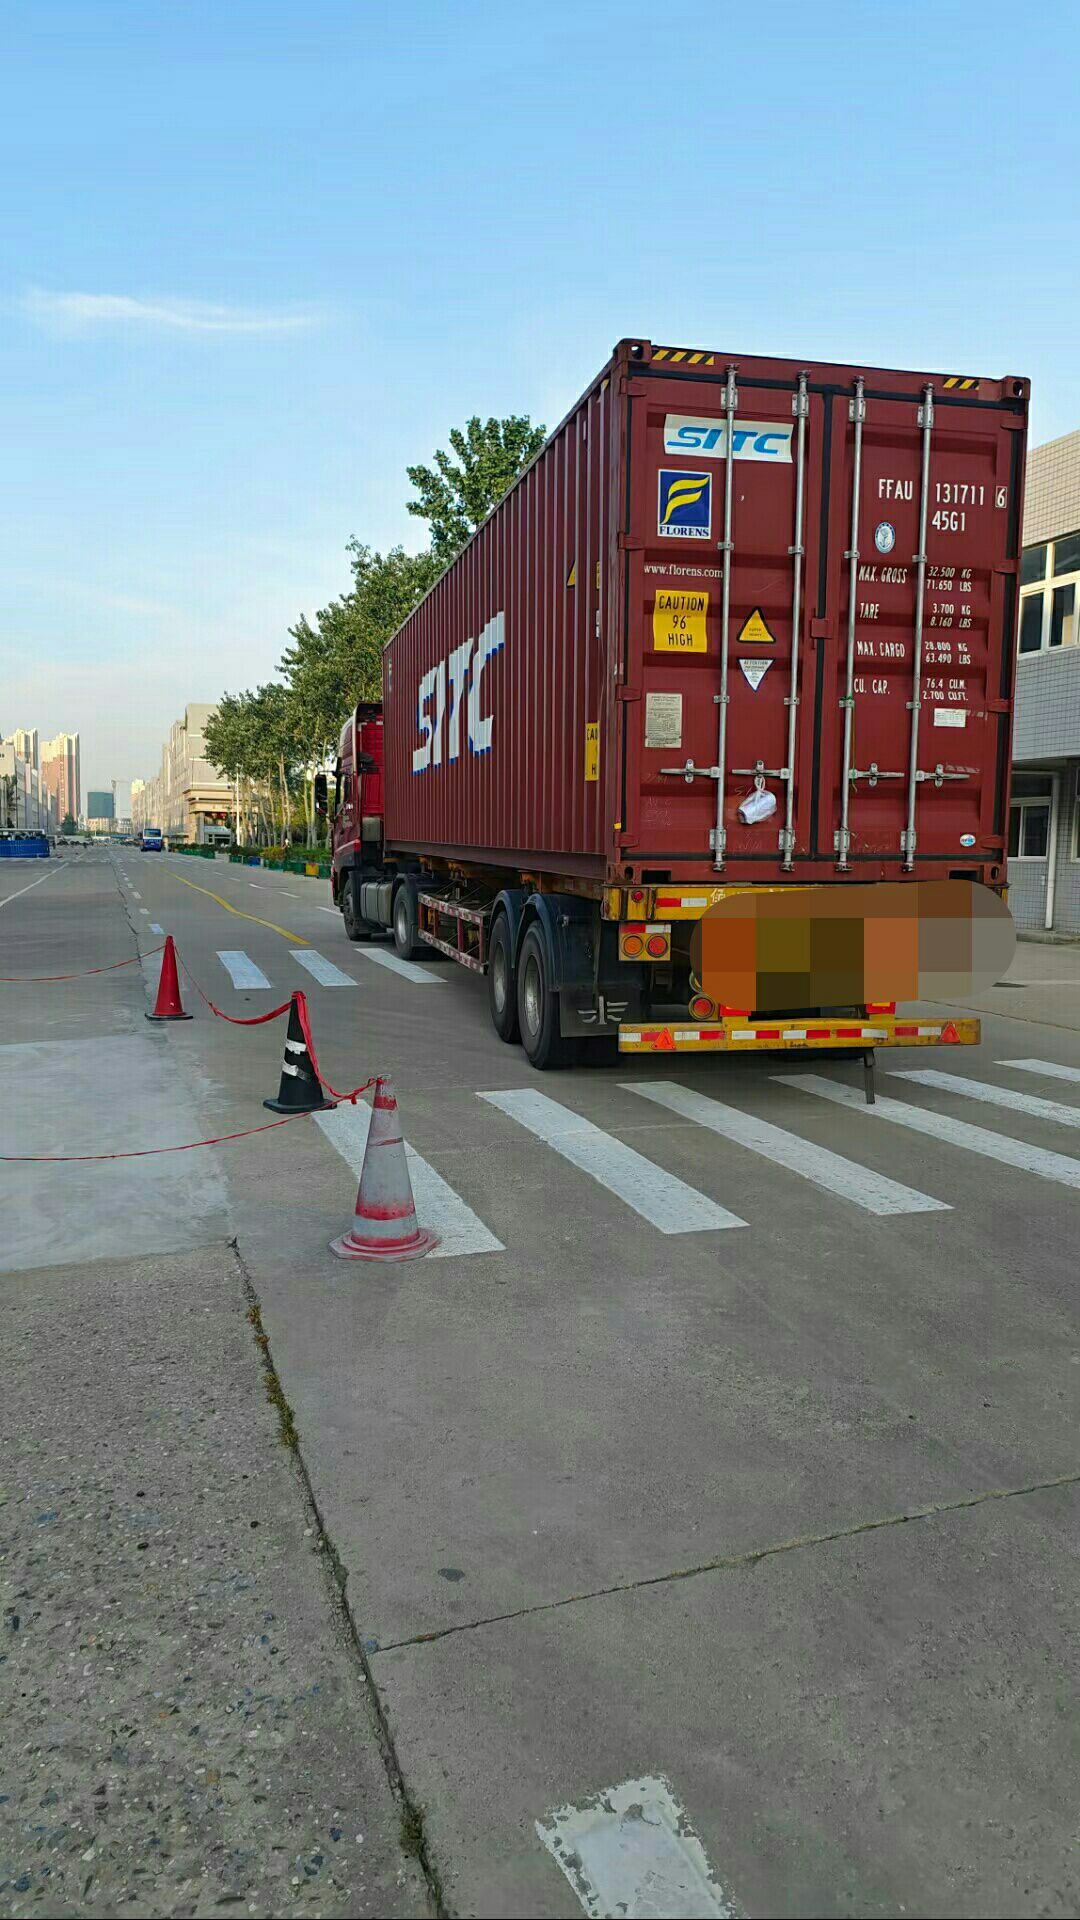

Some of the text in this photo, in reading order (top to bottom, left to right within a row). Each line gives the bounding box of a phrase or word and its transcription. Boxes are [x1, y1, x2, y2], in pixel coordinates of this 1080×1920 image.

[666, 426, 789, 454] SITC
[878, 479, 1006, 507] FFAU 131711 6
[932, 511, 966, 531] 45G1
[659, 526, 709, 537] FLORENS
[644, 564, 723, 578] www.florens.com
[859, 566, 972, 583] MAX. GROSS 32.500 KG
[927, 579, 972, 592] 71.650 LBS
[659, 595, 704, 611] CAUTION
[860, 602, 971, 619] TARE 3.700 KG
[930, 617, 972, 628] 8.160 LBS
[668, 633, 693, 646] HIGH
[857, 641, 877, 656] MAX.
[880, 642, 905, 658] CARGO
[958, 643, 968, 652] KG
[926, 653, 971, 665] 63.490 LBS
[412, 611, 504, 776] SITC
[854, 679, 867, 694] CU.
[872, 679, 891, 695] CAP.
[926, 678, 943, 689] 76.4
[923, 691, 944, 700] 2.700
